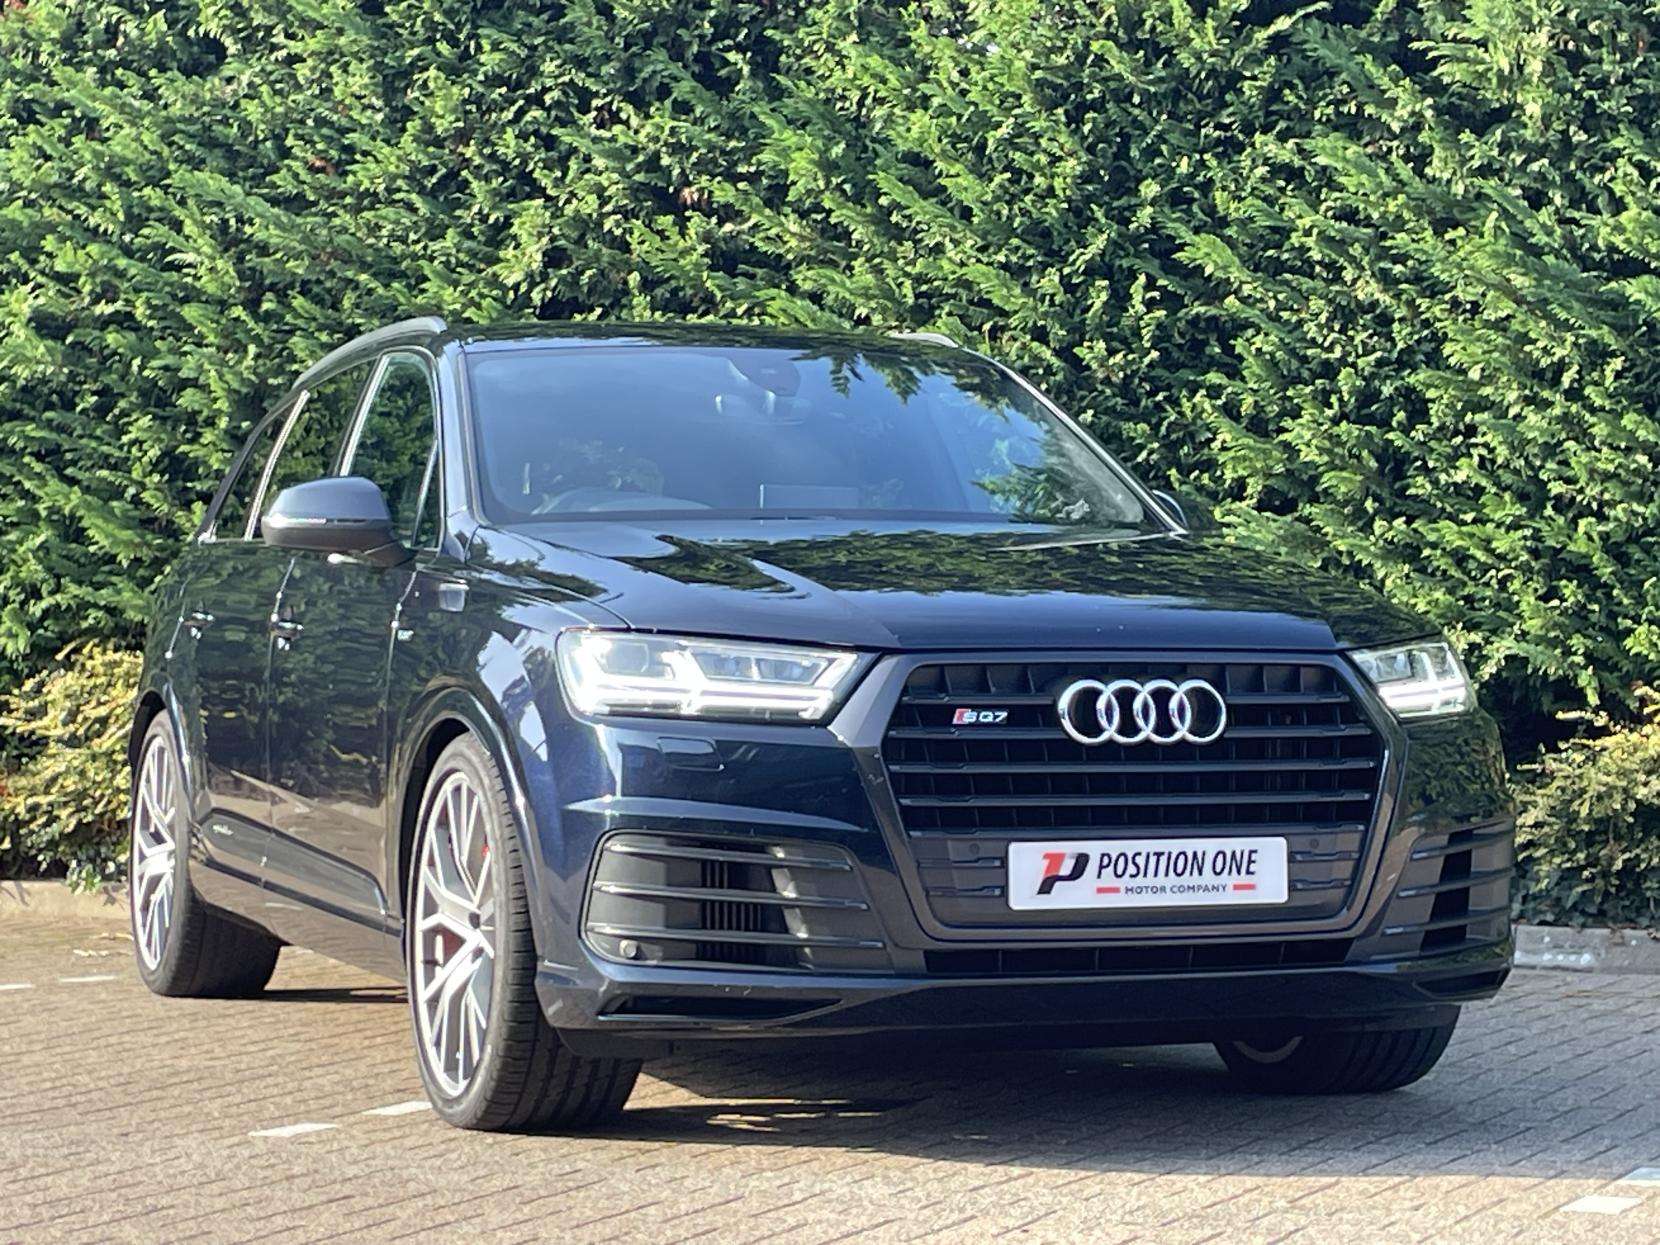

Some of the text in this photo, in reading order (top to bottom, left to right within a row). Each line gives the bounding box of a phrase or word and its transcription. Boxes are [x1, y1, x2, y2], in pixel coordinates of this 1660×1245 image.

[960, 710, 1008, 723] SQ7
[1096, 849, 1258, 879] POSITION ONE
[1124, 883, 1227, 894] MOTOR COMPANY
